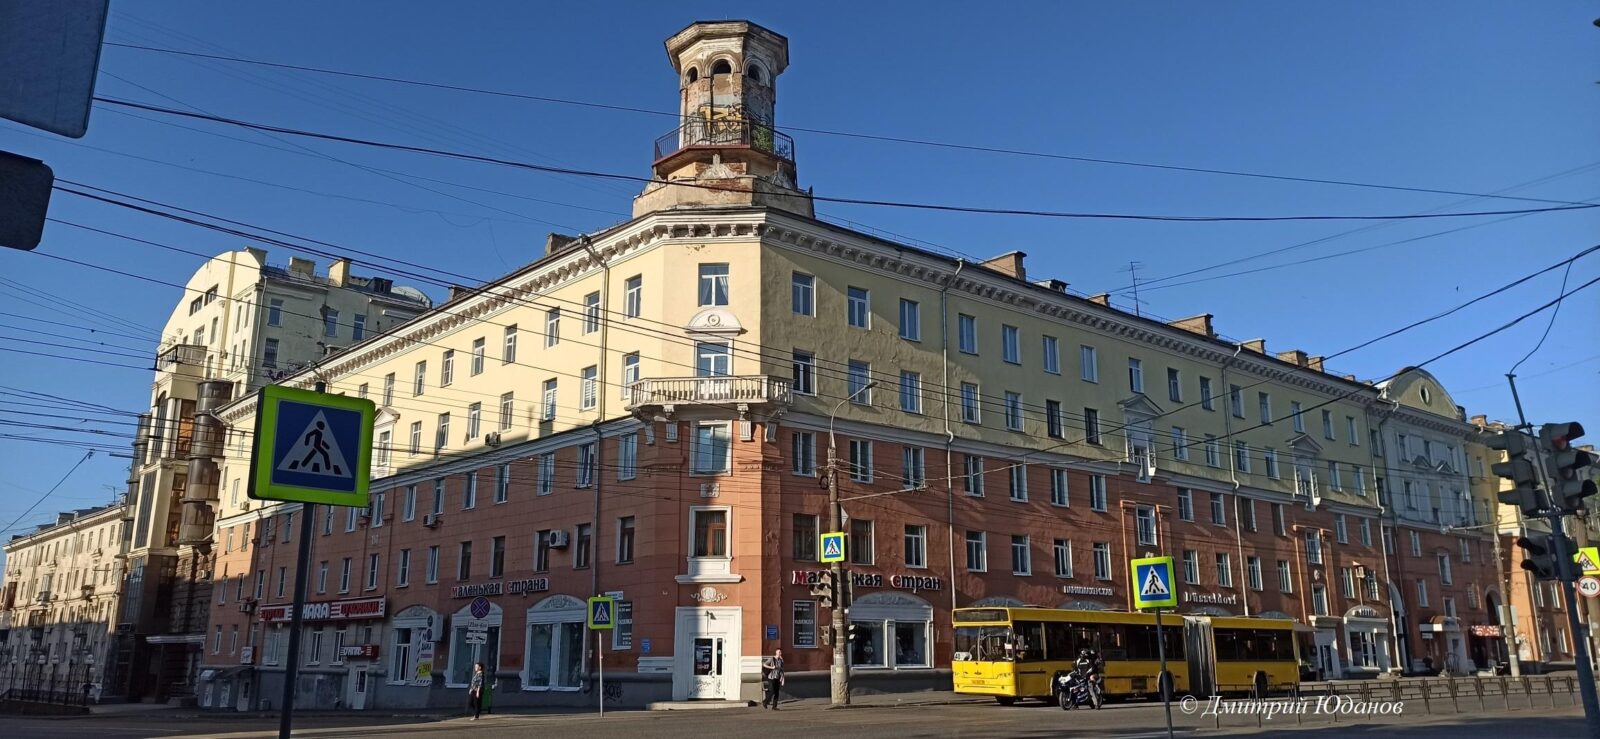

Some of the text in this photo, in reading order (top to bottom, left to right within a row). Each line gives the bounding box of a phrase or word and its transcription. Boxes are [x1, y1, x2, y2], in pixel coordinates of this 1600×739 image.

[452, 578, 547, 597] маленькая страна
[1582, 581, 1597, 591] 40
